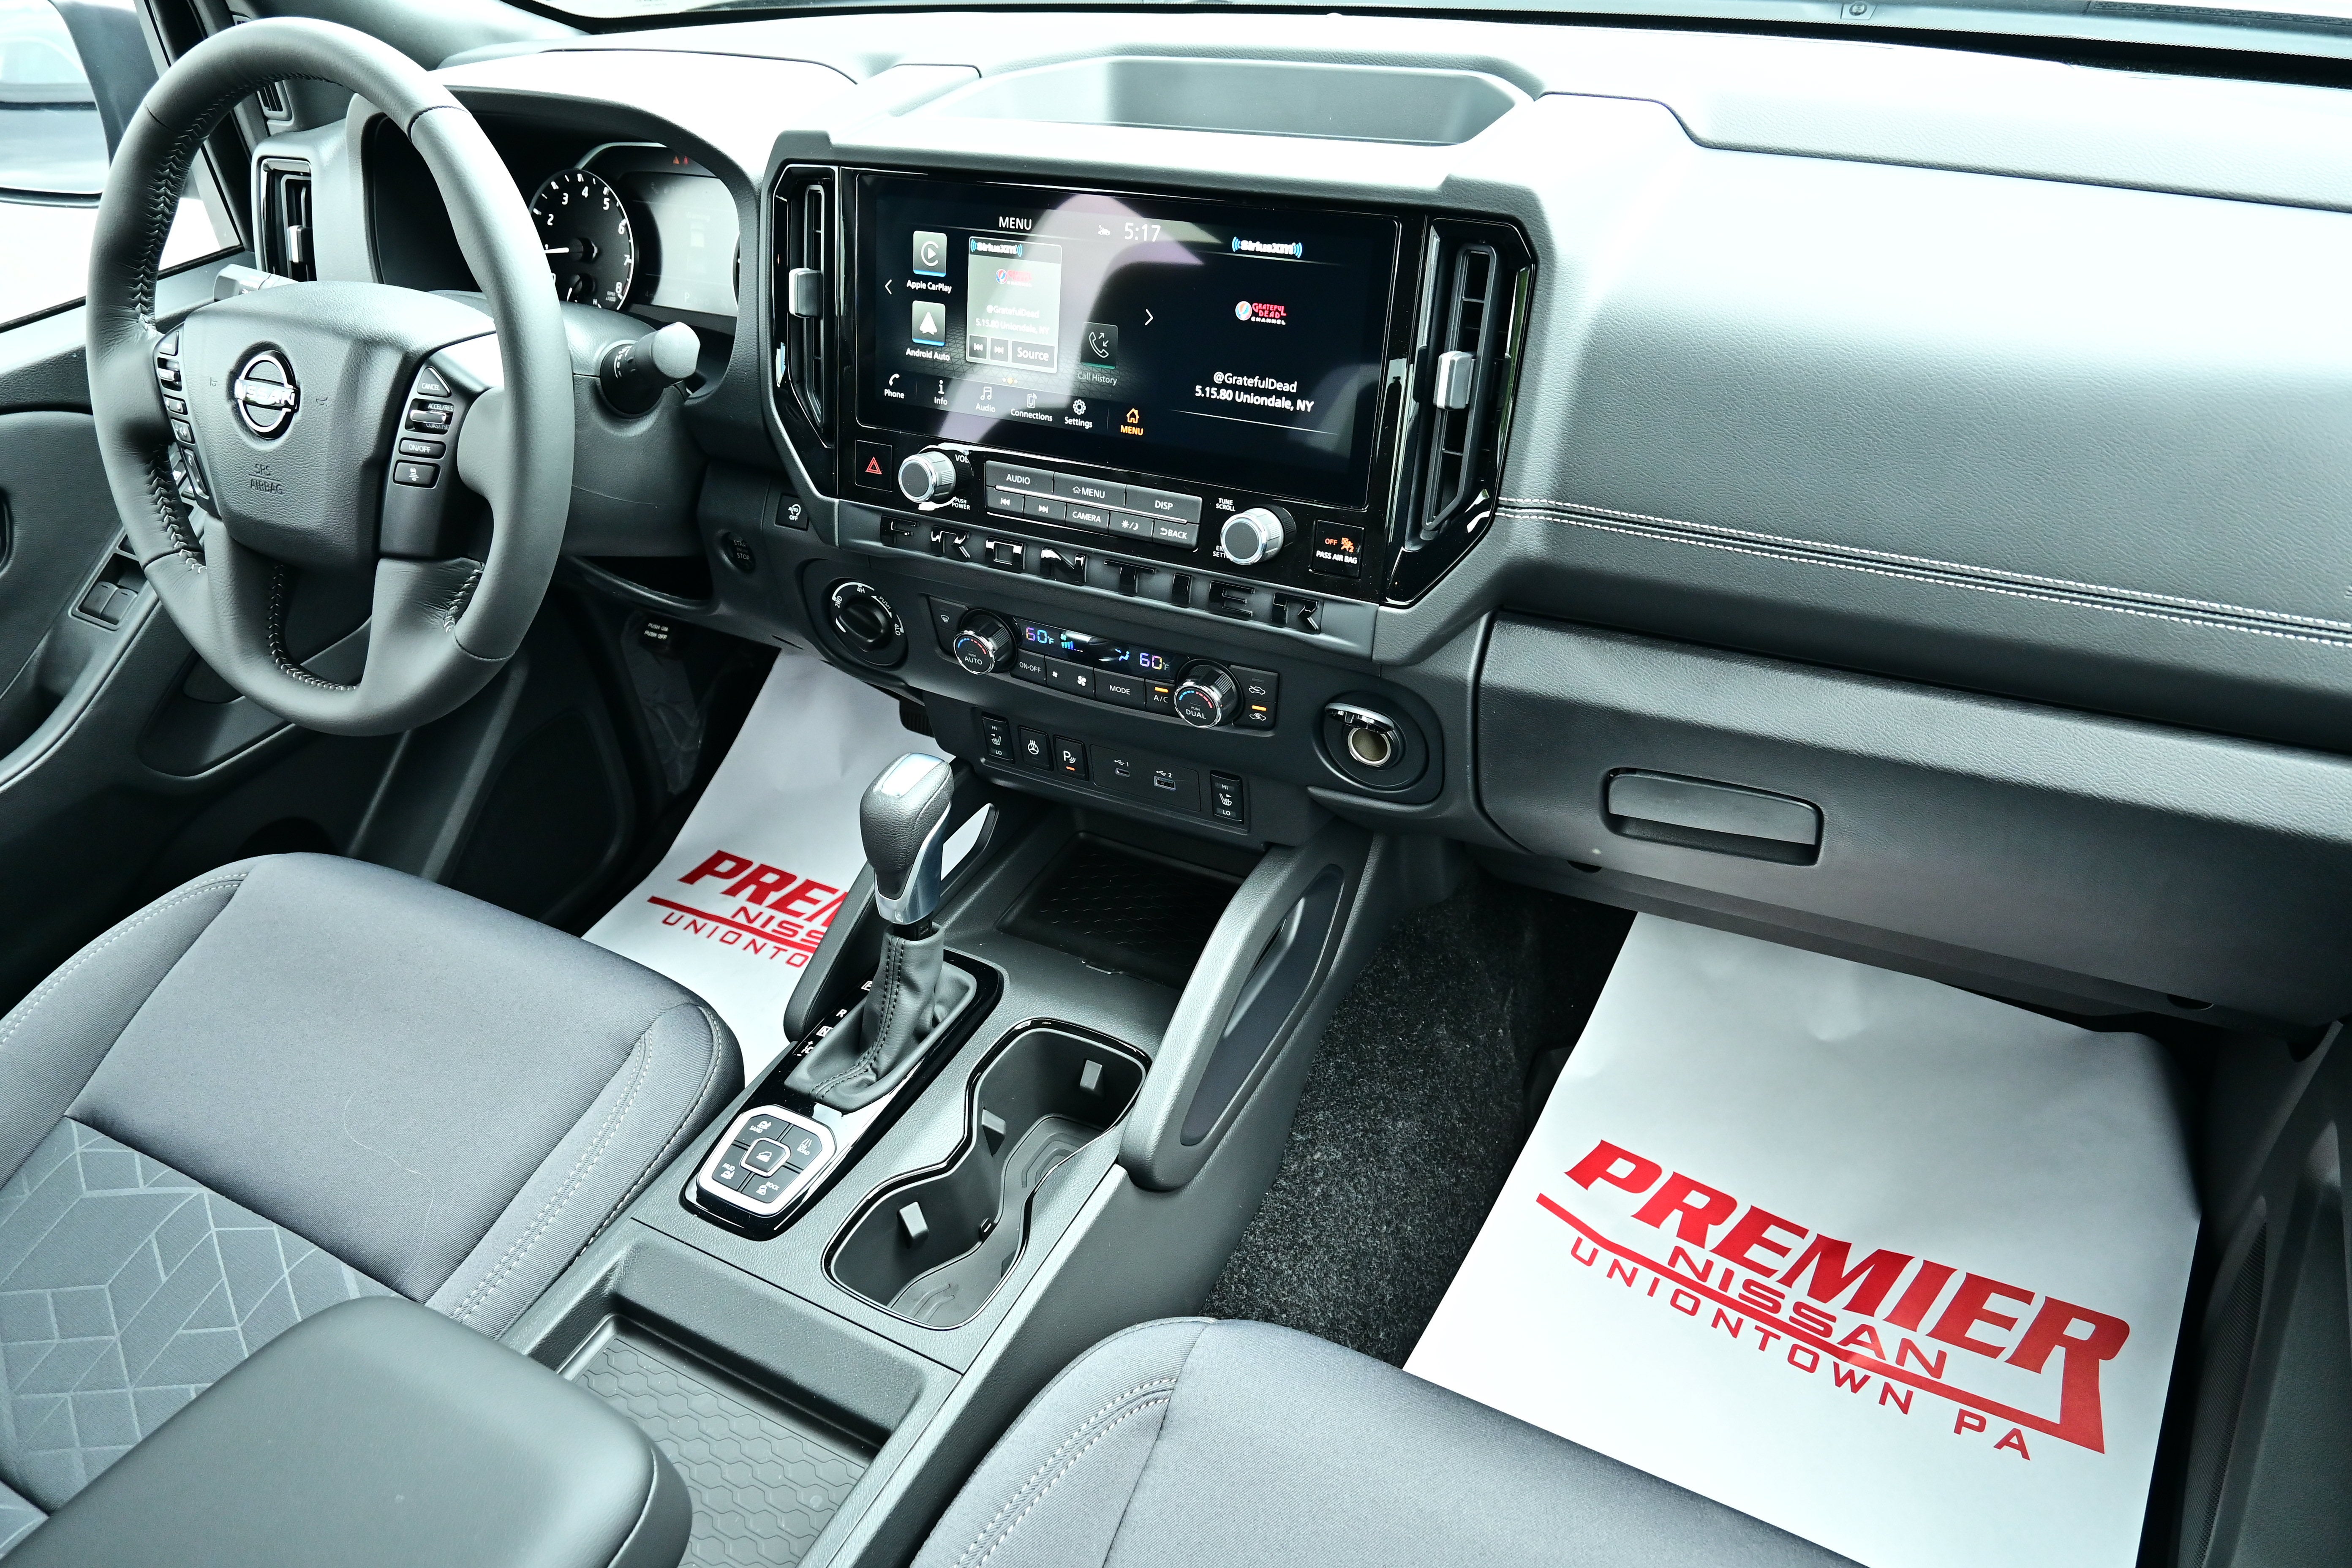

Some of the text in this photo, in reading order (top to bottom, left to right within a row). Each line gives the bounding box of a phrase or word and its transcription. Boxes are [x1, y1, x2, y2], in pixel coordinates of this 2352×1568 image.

[582, 186, 589, 198] 4
[562, 193, 569, 205] 3
[603, 198, 610, 210] 5
[547, 214, 554, 226] 2
[999, 216, 1032, 230] MENU
[618, 222, 625, 234] 6
[1124, 223, 1161, 242] 5:17
[615, 282, 622, 293] 8
[906, 279, 952, 294] Apple CarPlay
[1258, 310, 1280, 318] DEAD
[906, 348, 950, 361] Android Auto
[1017, 347, 1049, 362] Source
[1077, 371, 1118, 386] Call History
[1213, 371, 1298, 394] @GratefulDead
[421, 382, 441, 391] CANCEL
[884, 389, 905, 400] Phone
[1195, 386, 1315, 413] 5.15.80 Uniondale, NY
[427, 403, 454, 411] ACCEL/RES
[934, 396, 948, 406] Info
[975, 402, 996, 414] Audio
[1010, 408, 1053, 422] Connections
[1064, 416, 1093, 429] Settings
[1120, 425, 1144, 436] MENU
[408, 444, 431, 453] ON/OFF
[955, 454, 969, 463] VOL
[1006, 473, 1031, 486] AUDIO
[1081, 486, 1106, 499] MENU
[952, 502, 970, 510] POWER
[1154, 500, 1173, 511] DISP
[1216, 503, 1236, 512] SCROLL
[1218, 498, 1233, 506] TUNE
[1072, 511, 1102, 524] CAMERA
[1167, 528, 1188, 541] BACK
[1325, 538, 1338, 546] OFF
[737, 552, 750, 560] STOP
[1316, 550, 1358, 564] PASS AIR BAG
[880, 514, 1320, 633] FRONTIER
[835, 595, 843, 609] 2WD
[879, 596, 891, 610] PUSH
[644, 630, 657, 638] PUSH
[964, 656, 983, 665] AUTO
[1109, 684, 1131, 696] MODE
[1153, 694, 1168, 703] A/C
[1185, 709, 1207, 719] DUAL
[730, 906, 826, 945] NISS
[662, 912, 811, 969] UNIONTO
[836, 1009, 847, 1018] R
[749, 1125, 763, 1134] SAND
[722, 1162, 735, 1171] MUD
[765, 1181, 780, 1191] ROCK
[1564, 1139, 2131, 1455] PREMIER
[1667, 1245, 1947, 1380] NISSAN
[1570, 1236, 2031, 1462] UNIONTOWN PA
